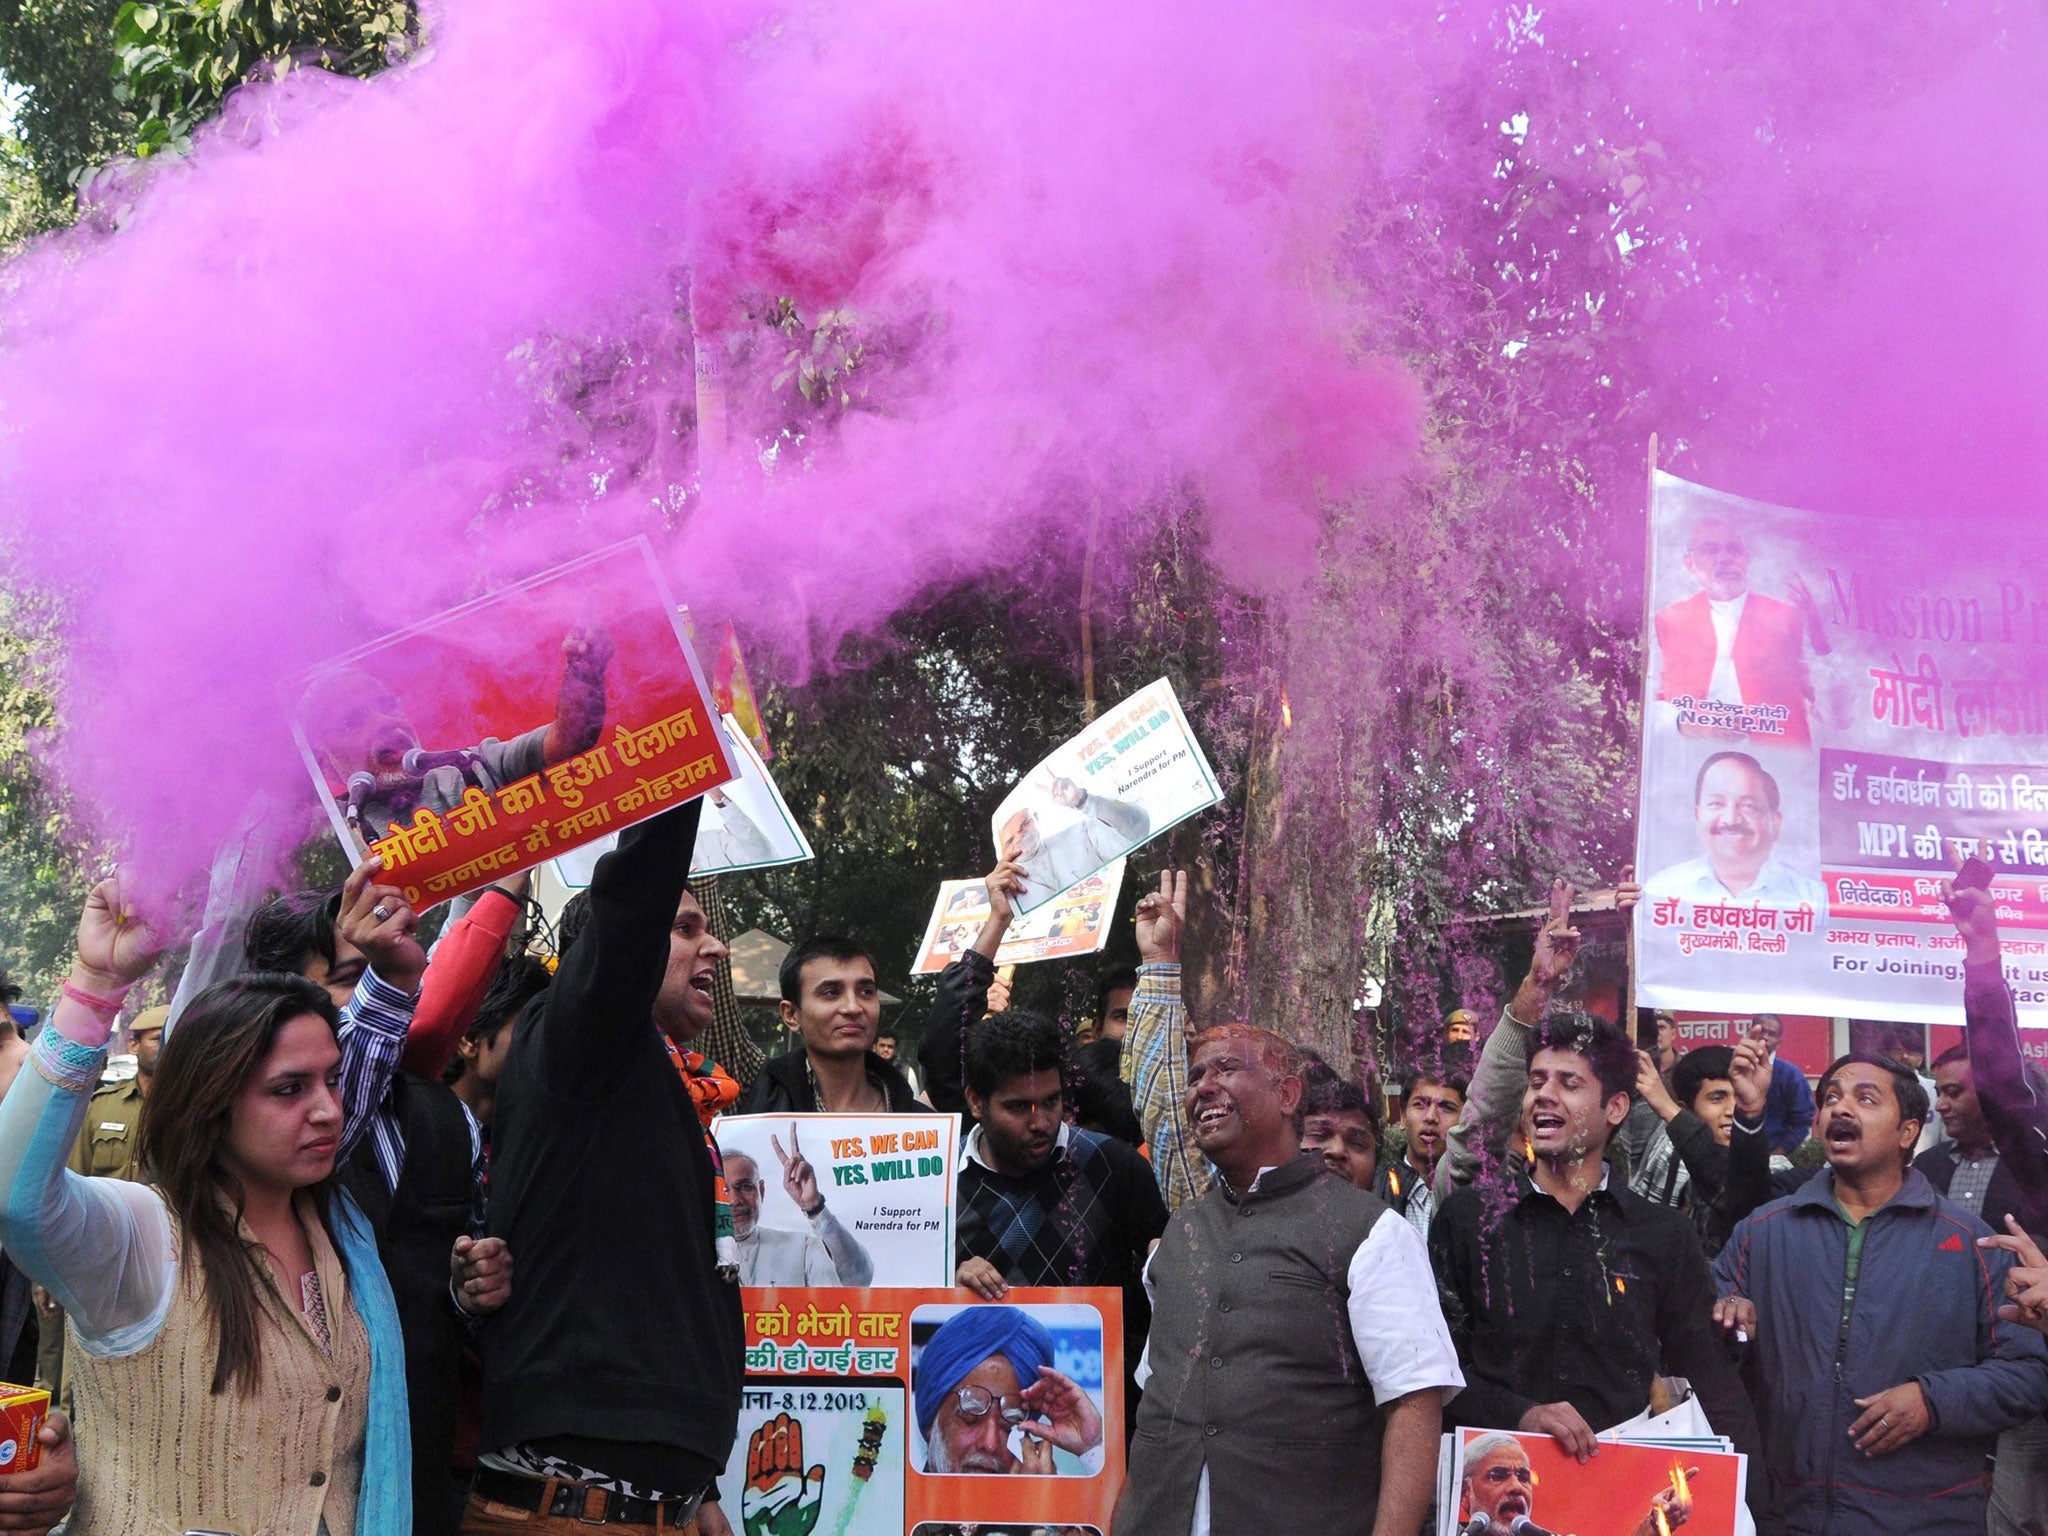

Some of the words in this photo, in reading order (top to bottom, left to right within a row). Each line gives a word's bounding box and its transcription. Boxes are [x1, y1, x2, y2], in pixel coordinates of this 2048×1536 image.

[1869, 651, 1944, 731] मोदी
[1672, 695, 1694, 709] श्री
[1750, 705, 1788, 719] मोदी
[1680, 710, 1733, 728] Next
[1742, 717, 1784, 733] P.M.
[1112, 725, 1150, 754] WILL
[1147, 710, 1170, 730] DO
[1117, 768, 1157, 795] Narendra
[1158, 759, 1171, 771] for
[1173, 750, 1186, 763] PM
[1134, 749, 1167, 773] Support
[371, 808, 449, 871] मोदी
[446, 788, 499, 837] जी
[496, 774, 546, 816] का
[545, 746, 614, 808] हुआ
[612, 707, 699, 768] ऐलान
[1867, 766, 1940, 806] हर्षवर्धन
[1944, 773, 1973, 809] जी
[1978, 775, 2006, 811] को
[423, 843, 519, 894] जनपद
[522, 819, 551, 854] में
[554, 801, 612, 840] मचा
[613, 752, 718, 814] कोहराम
[1858, 821, 1909, 859] MPI
[1912, 825, 1943, 861] की
[1998, 830, 2018, 865] से
[1653, 897, 1685, 926] डॉ.
[1693, 898, 1778, 930] हर्षवर्धन
[1783, 902, 1814, 933] जी
[1748, 932, 1786, 953] दिल्ली
[1827, 930, 1870, 945] अभय
[1833, 956, 1868, 972] For
[1875, 959, 1964, 980] Joining,
[1677, 1020, 1729, 1040] जनता
[830, 1137, 867, 1159] YES,
[870, 1133, 898, 1155] WE
[902, 1129, 938, 1151] CAN
[832, 1164, 869, 1186] YES,
[870, 1159, 915, 1182] WILL
[918, 1156, 943, 1177] DO
[855, 1220, 903, 1231] Narendra
[906, 1220, 921, 1231] for
[924, 1221, 940, 1231] PM
[873, 1206, 877, 1216] I
[880, 1206, 921, 1218] Support
[755, 1304, 791, 1337] को
[797, 1304, 852, 1337] भेजो
[857, 1313, 902, 1338] तार
[745, 1342, 778, 1368] की
[783, 1342, 808, 1370] हो
[813, 1342, 852, 1371] गई
[857, 1351, 896, 1371] हार
